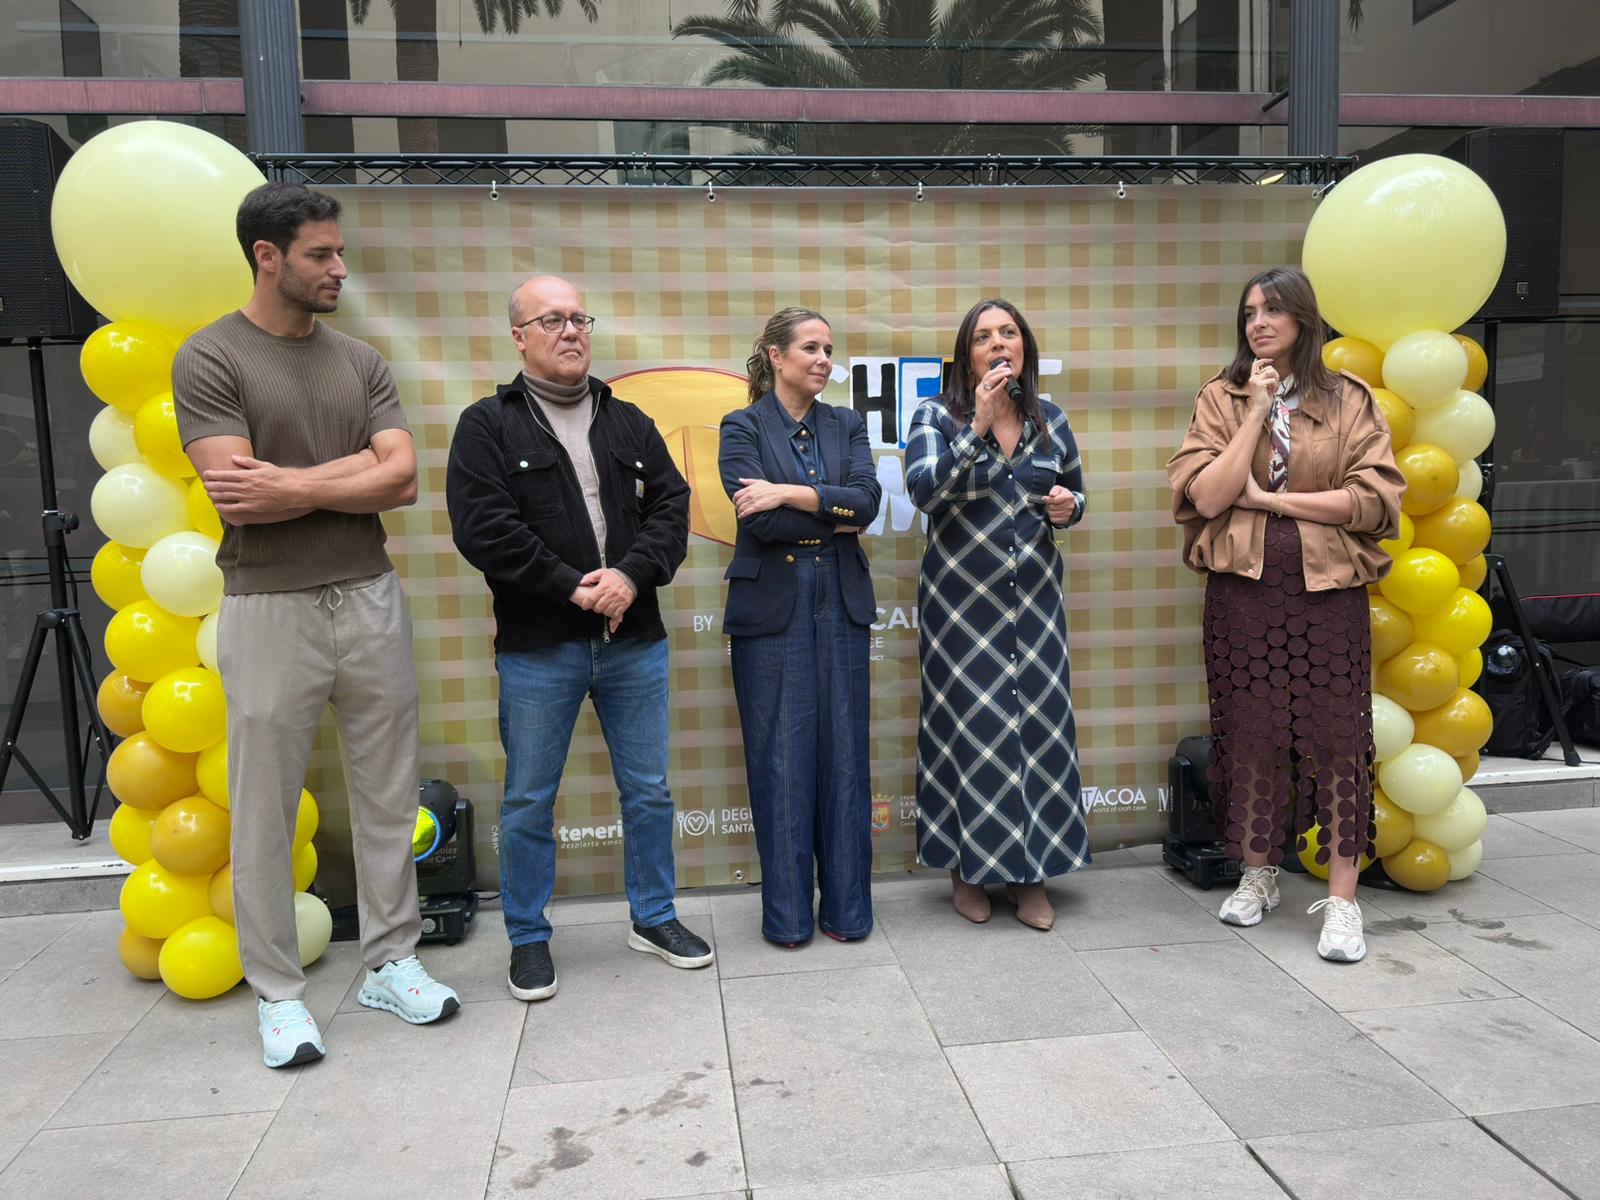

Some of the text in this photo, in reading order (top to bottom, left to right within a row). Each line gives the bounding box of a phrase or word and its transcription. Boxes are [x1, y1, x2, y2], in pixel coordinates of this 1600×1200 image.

[693, 615, 714, 632] BY
[1081, 786, 1147, 815] TACOA
[722, 823, 755, 834] SANTA
